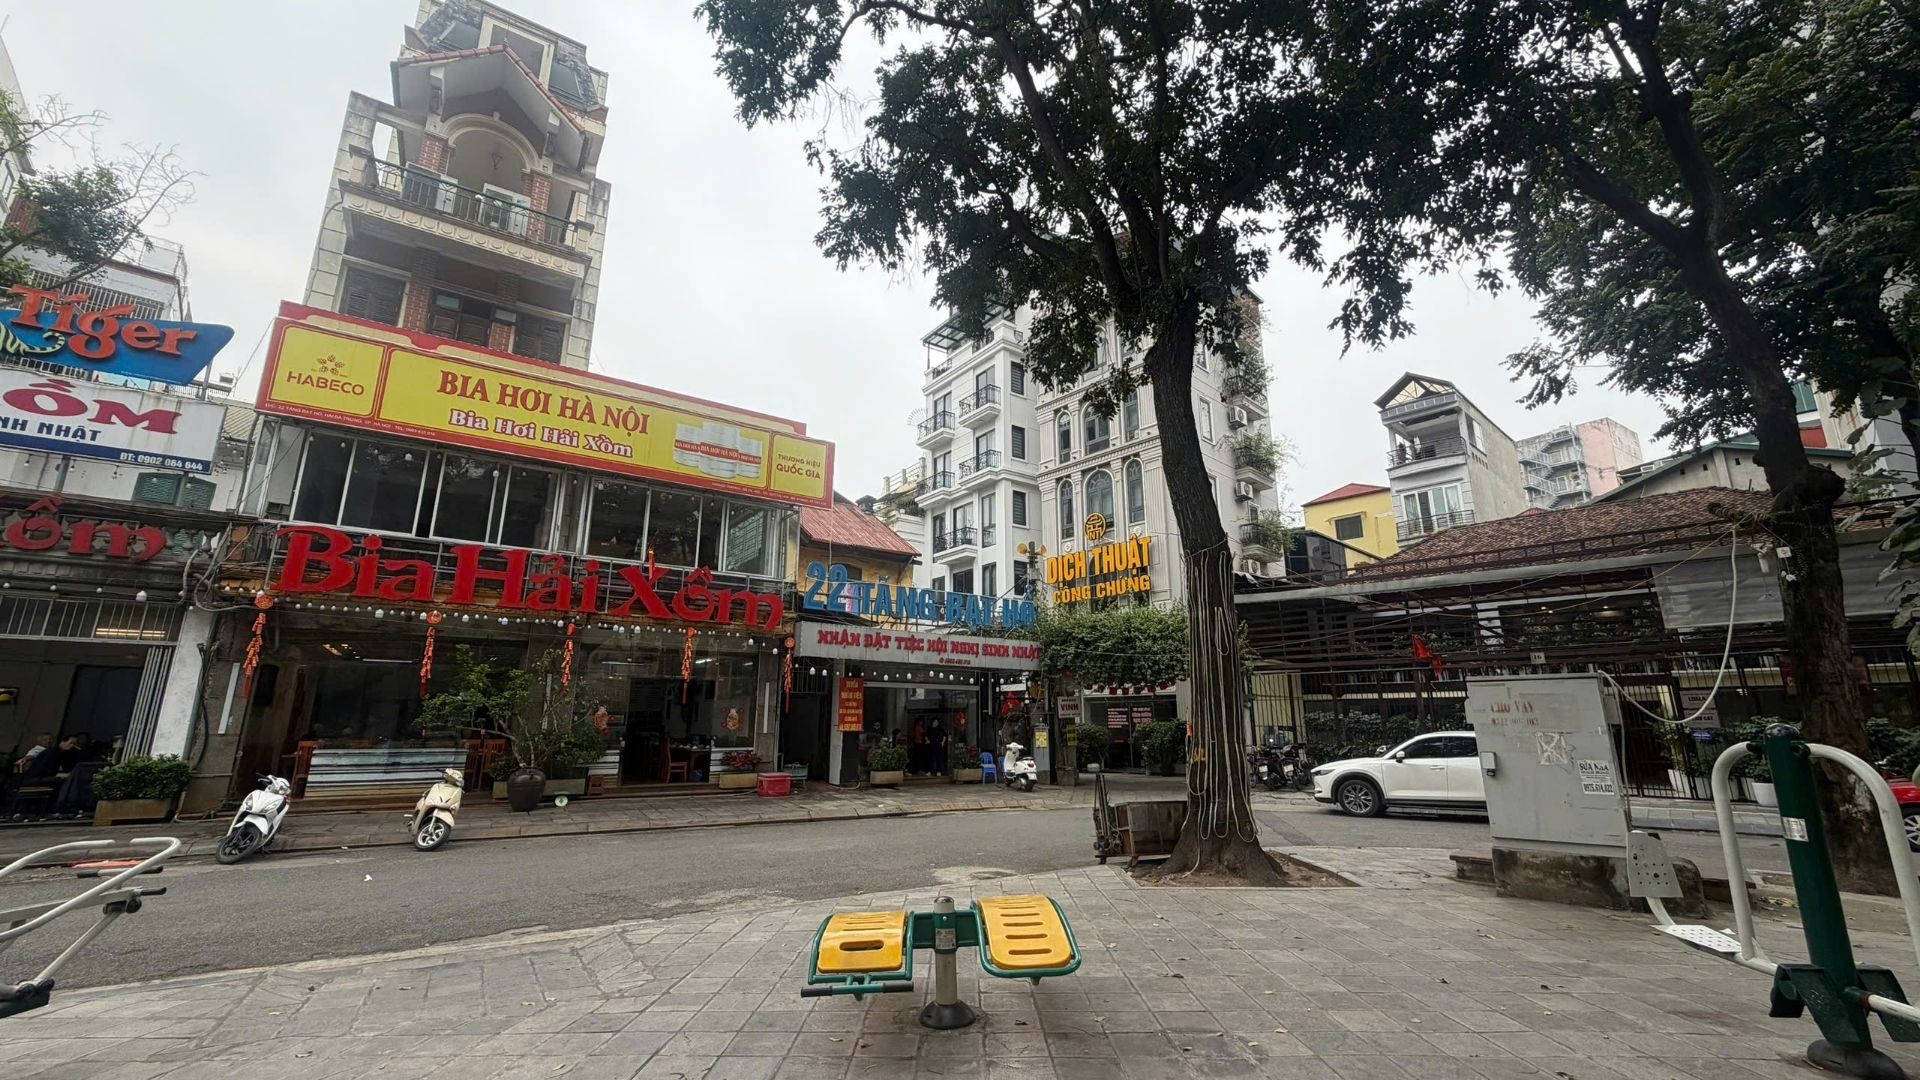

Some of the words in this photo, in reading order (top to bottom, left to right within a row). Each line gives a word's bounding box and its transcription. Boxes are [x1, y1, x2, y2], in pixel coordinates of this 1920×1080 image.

[8, 284, 197, 360] Tiger
[286, 370, 365, 396] HABECO
[437, 370, 490, 403] BIA
[496, 383, 553, 415] HƠI
[557, 395, 597, 424] HÀ
[602, 405, 650, 437] NỘI
[37, 425, 102, 442] NHẬT
[449, 408, 489, 431] Bia
[494, 417, 536, 441] Hơi
[540, 426, 580, 448] Hải
[137, 454, 163, 465] 0902
[776, 463, 804, 476] QUỐC
[805, 469, 821, 479] GIA
[269, 525, 436, 601] Bia
[444, 544, 600, 613] Hải
[1046, 549, 1088, 588] DỊCH
[1092, 533, 1152, 575] THUẬT
[803, 560, 848, 612] 22
[946, 591, 994, 632] BẠT
[1052, 585, 1092, 606] CÔNG
[1096, 574, 1152, 598] CHỨNG
[817, 628, 861, 648] NHẬN
[864, 632, 892, 651] ĐẶT
[895, 634, 925, 653] TIỆC
[927, 637, 948, 655] HỘI
[950, 640, 979, 658] NGHỊ
[982, 643, 1010, 658] SINH
